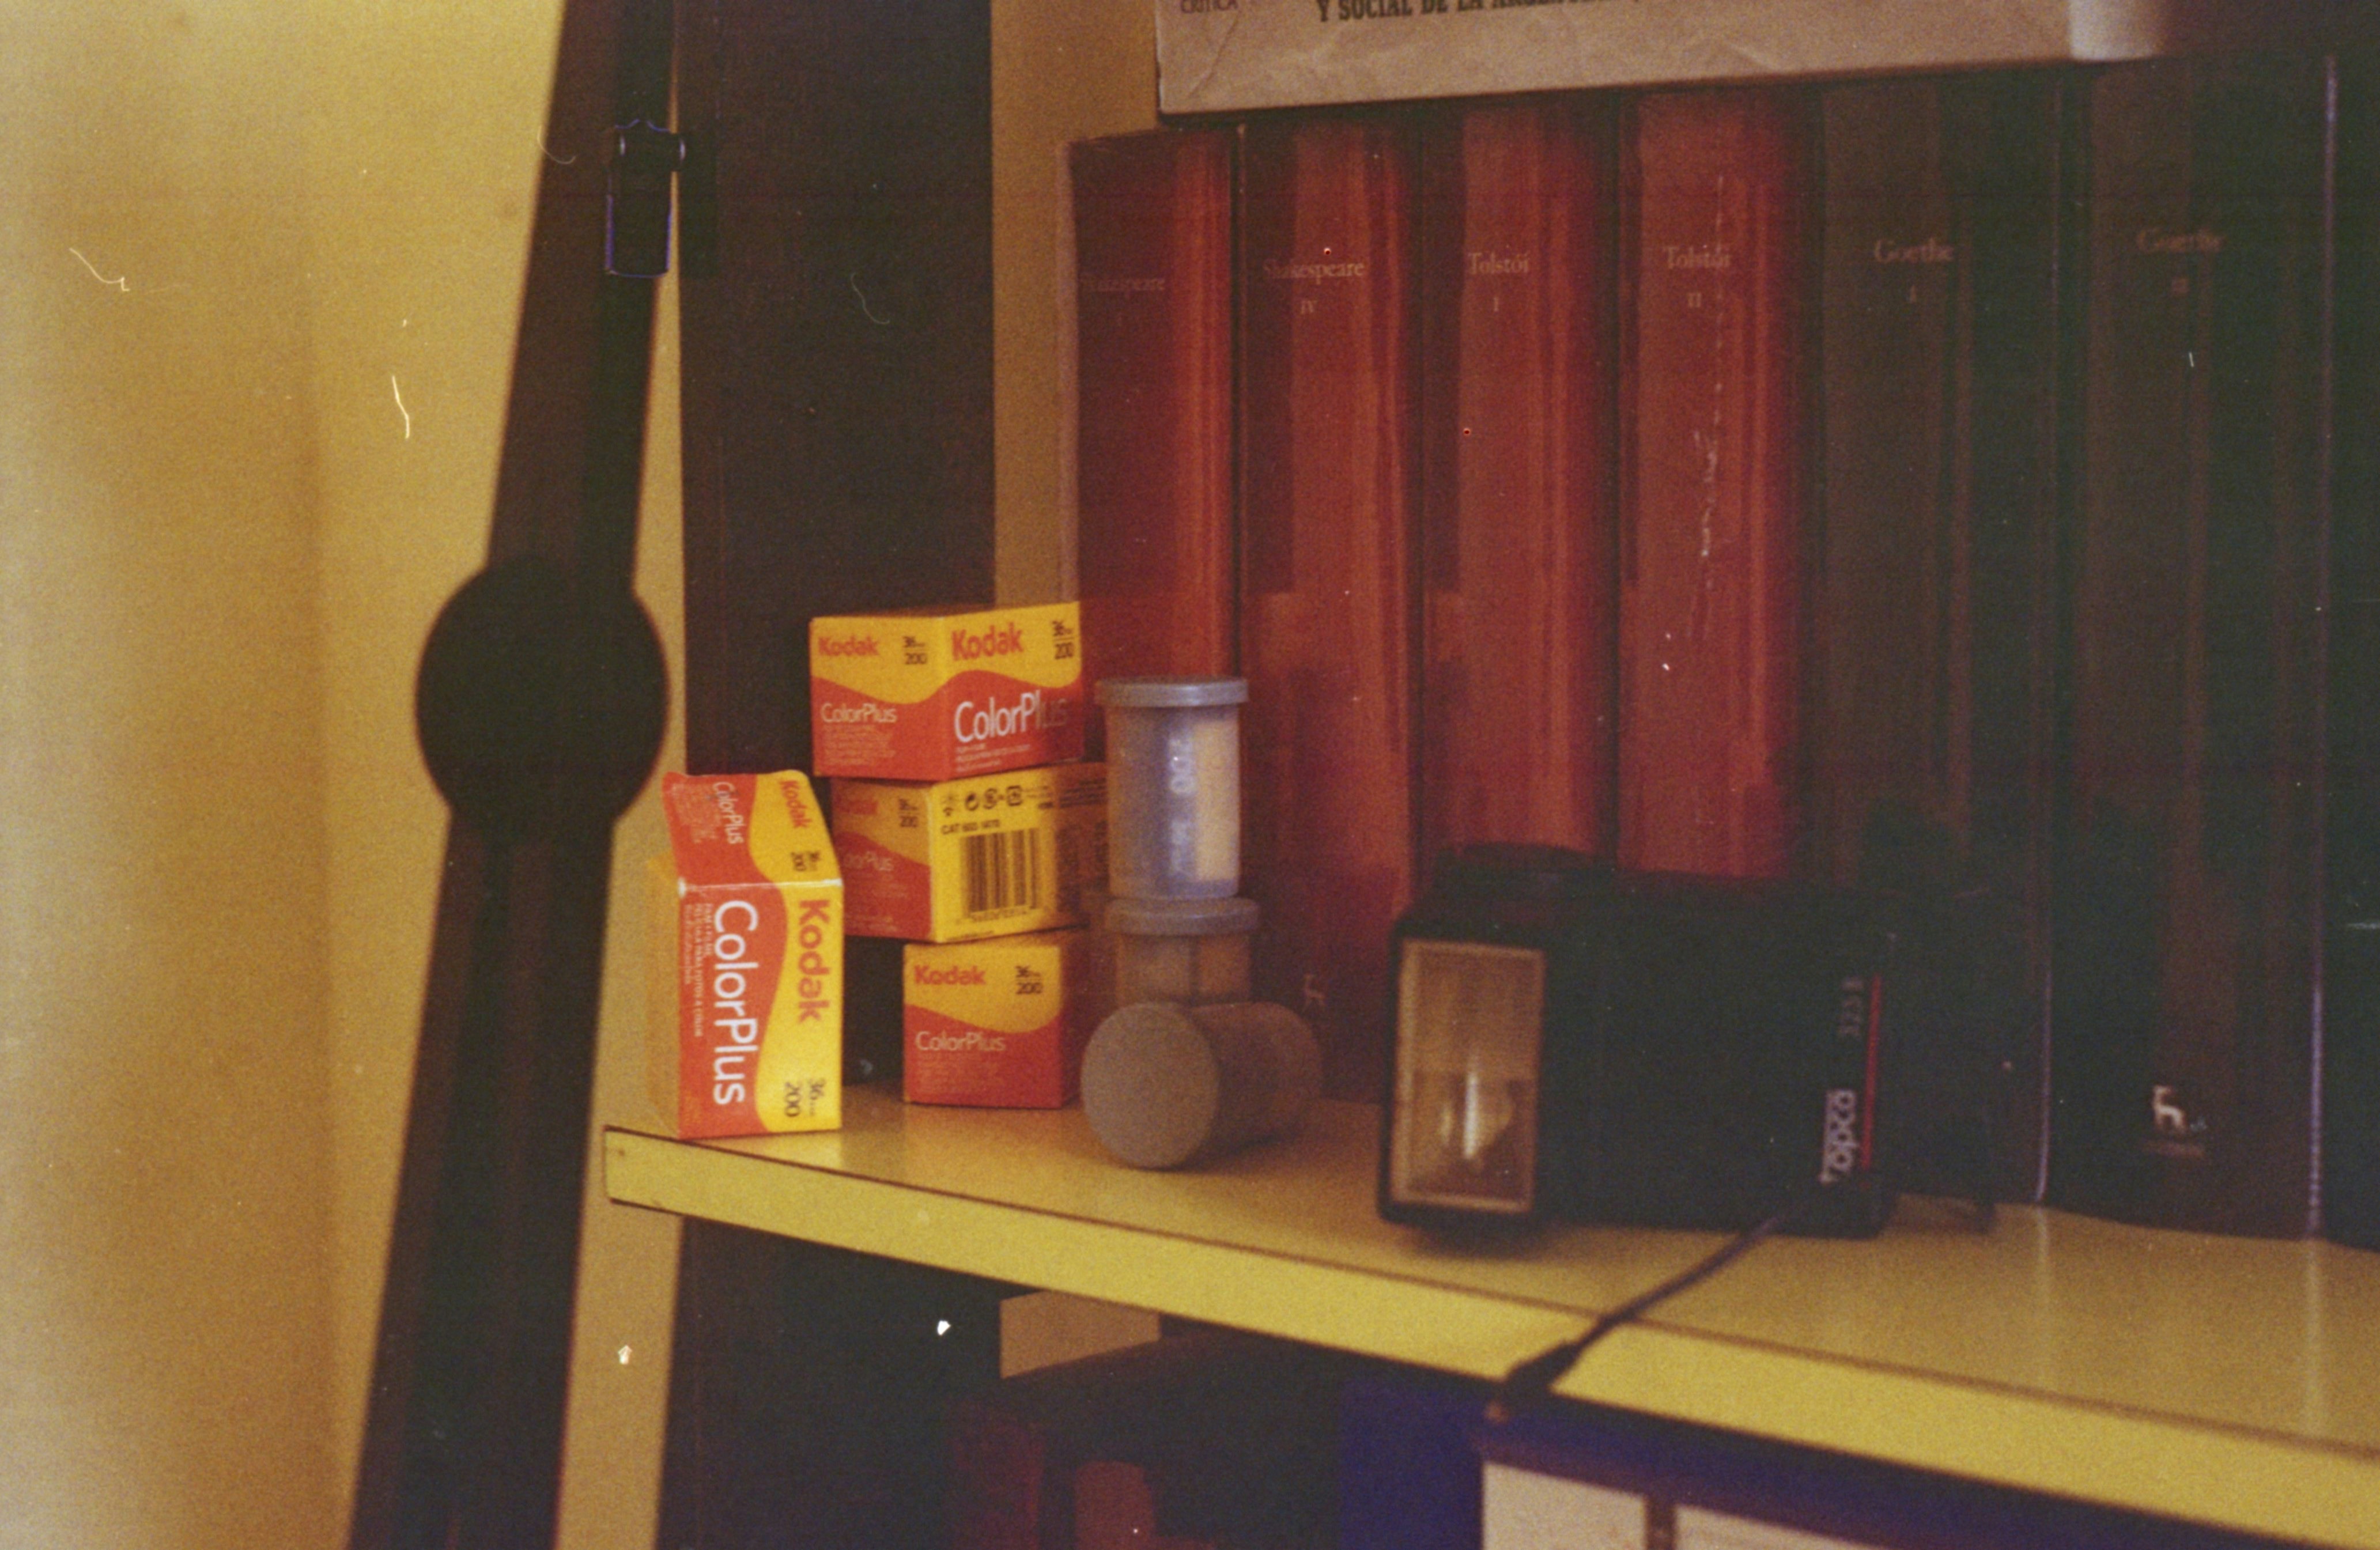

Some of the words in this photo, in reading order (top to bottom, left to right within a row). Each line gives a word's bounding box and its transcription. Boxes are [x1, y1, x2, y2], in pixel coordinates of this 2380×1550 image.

[1338, 0, 1413, 20] SOCIAL
[817, 635, 880, 657] Kodak
[951, 622, 1025, 661] Kodak
[1055, 642, 1074, 660] 200
[905, 652, 928, 665] 200
[820, 702, 897, 724] ColorPlus
[954, 689, 1068, 743] ColorPlus
[713, 781, 745, 845] ColorPlus
[779, 780, 814, 829] Kodak
[799, 899, 831, 1024] Kodak
[914, 965, 987, 986] Kodak
[713, 900, 760, 1105] ColorPlus
[915, 1030, 1006, 1052] ColorPlus
[784, 1082, 802, 1117] 200
